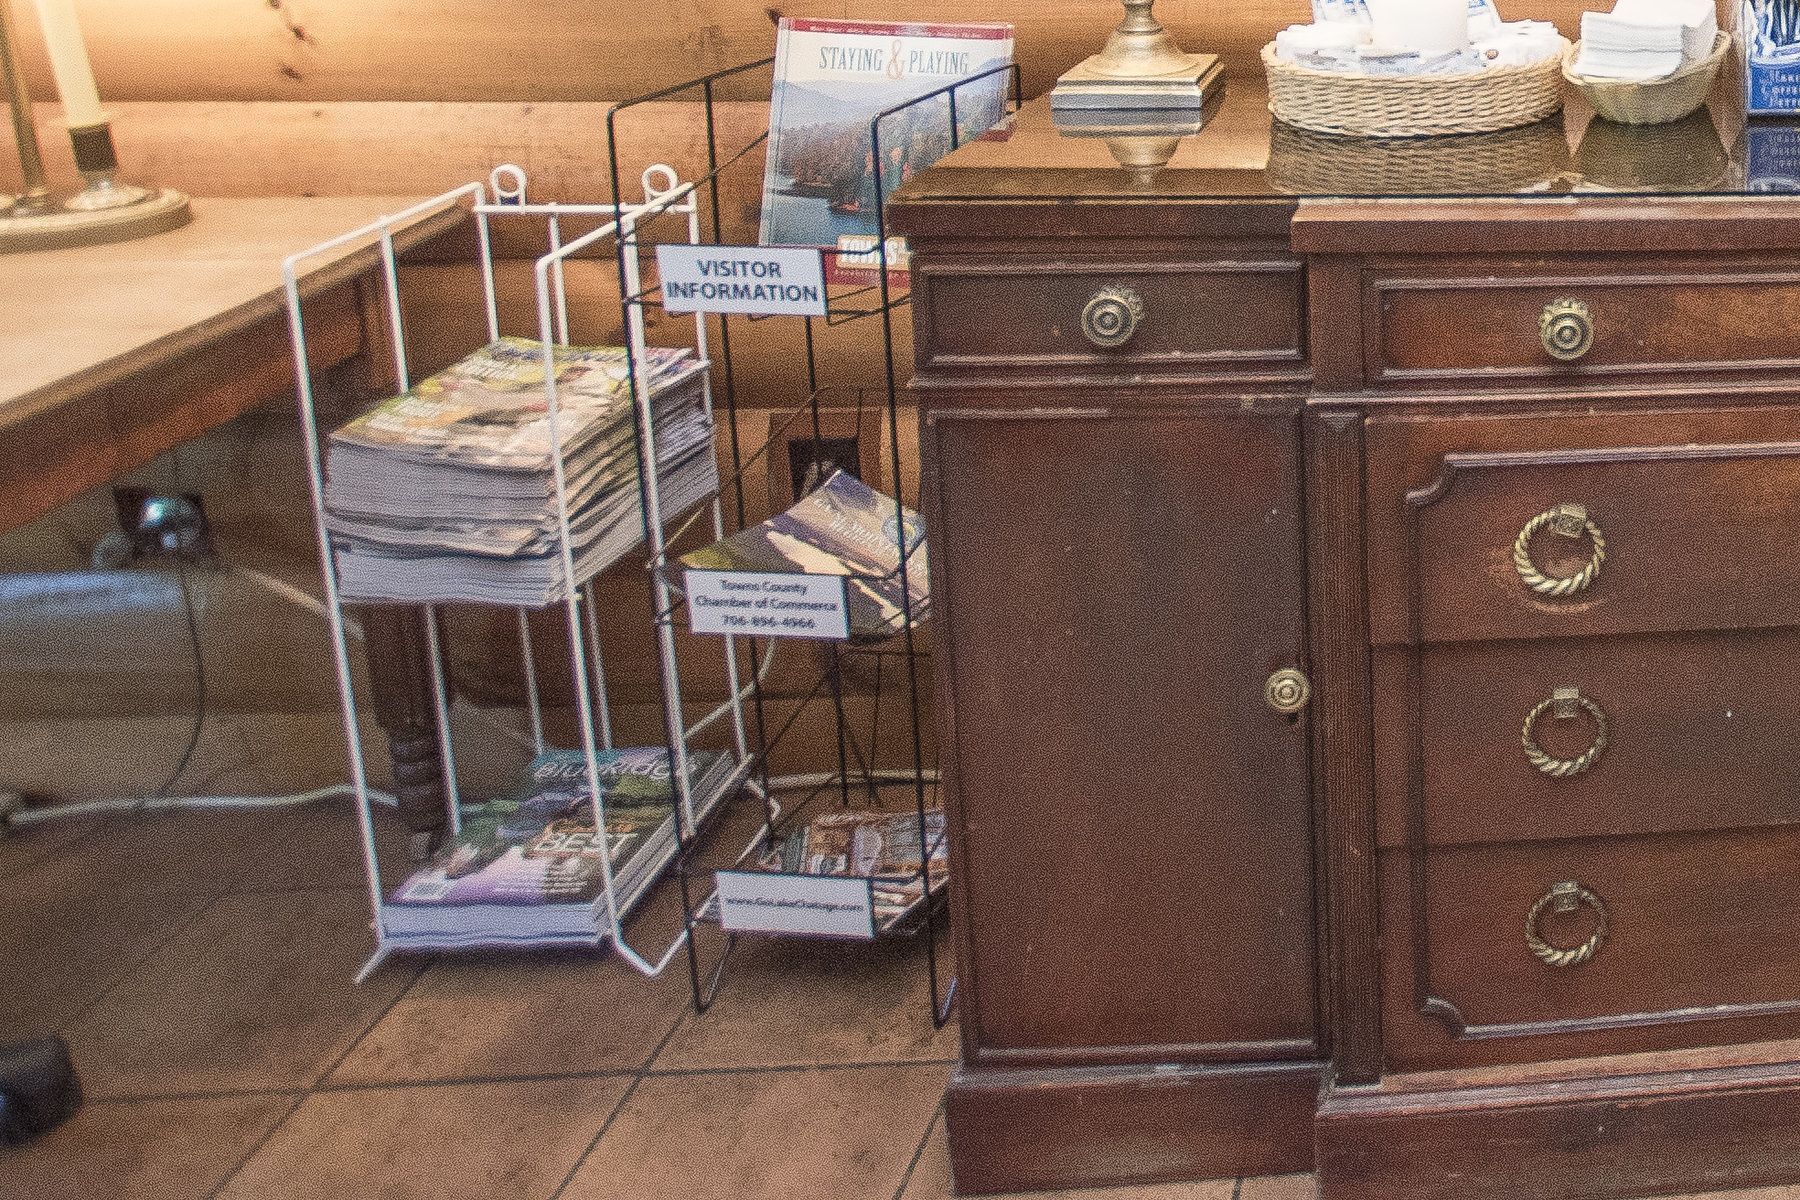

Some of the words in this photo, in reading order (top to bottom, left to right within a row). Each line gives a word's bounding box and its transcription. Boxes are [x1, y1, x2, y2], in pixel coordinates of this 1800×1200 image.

[819, 46, 883, 71] STAYING
[886, 39, 905, 80] &
[909, 50, 970, 75] PLAYING
[697, 259, 782, 278] VISITOR
[667, 281, 818, 302] INFORMATION
[721, 579, 760, 591] Towns
[762, 581, 808, 596] County
[695, 595, 752, 609] Chamber
[755, 597, 767, 609] of
[770, 597, 838, 611] Commerce
[533, 832, 638, 853] BEST
